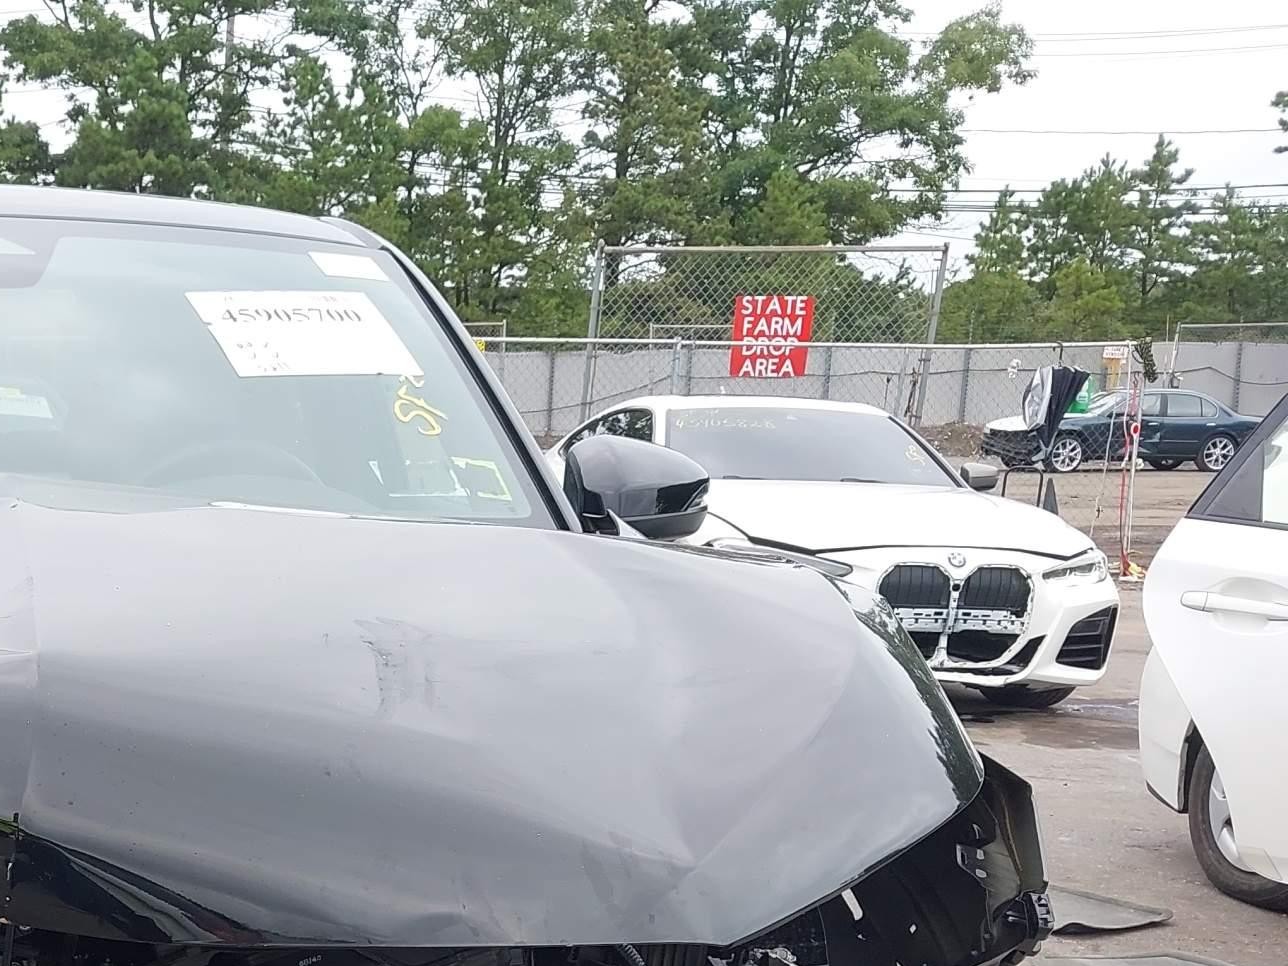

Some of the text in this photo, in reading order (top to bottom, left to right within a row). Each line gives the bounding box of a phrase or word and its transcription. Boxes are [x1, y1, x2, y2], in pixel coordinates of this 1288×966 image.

[740, 295, 808, 315] STATE
[742, 317, 803, 336] FARM
[741, 336, 799, 356] DROP
[738, 358, 795, 377] AREA
